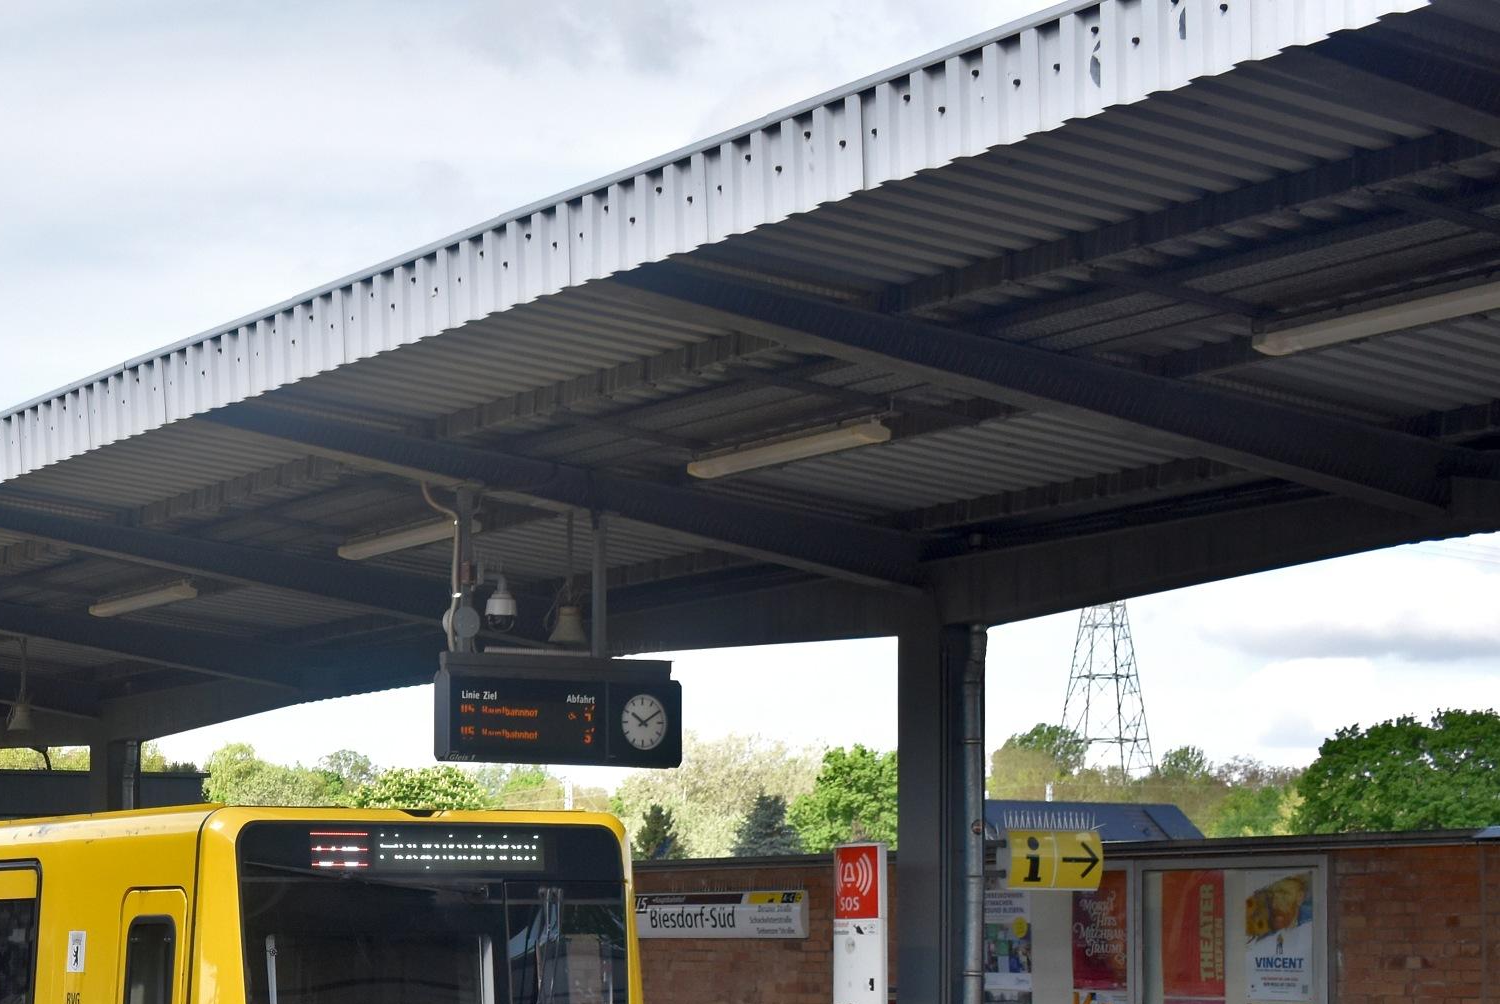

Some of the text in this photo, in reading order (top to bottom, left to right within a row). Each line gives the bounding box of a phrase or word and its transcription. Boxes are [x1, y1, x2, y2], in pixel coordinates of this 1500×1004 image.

[461, 690, 497, 701] Linie Ziel
[566, 694, 595, 704] Abfahrt
[449, 753, 469, 762] Gleis
[840, 896, 860, 912] SOS
[650, 905, 736, 930] Biesdorf-Süd
[1199, 884, 1215, 982] THEATER
[1255, 956, 1305, 969] VINCENT
